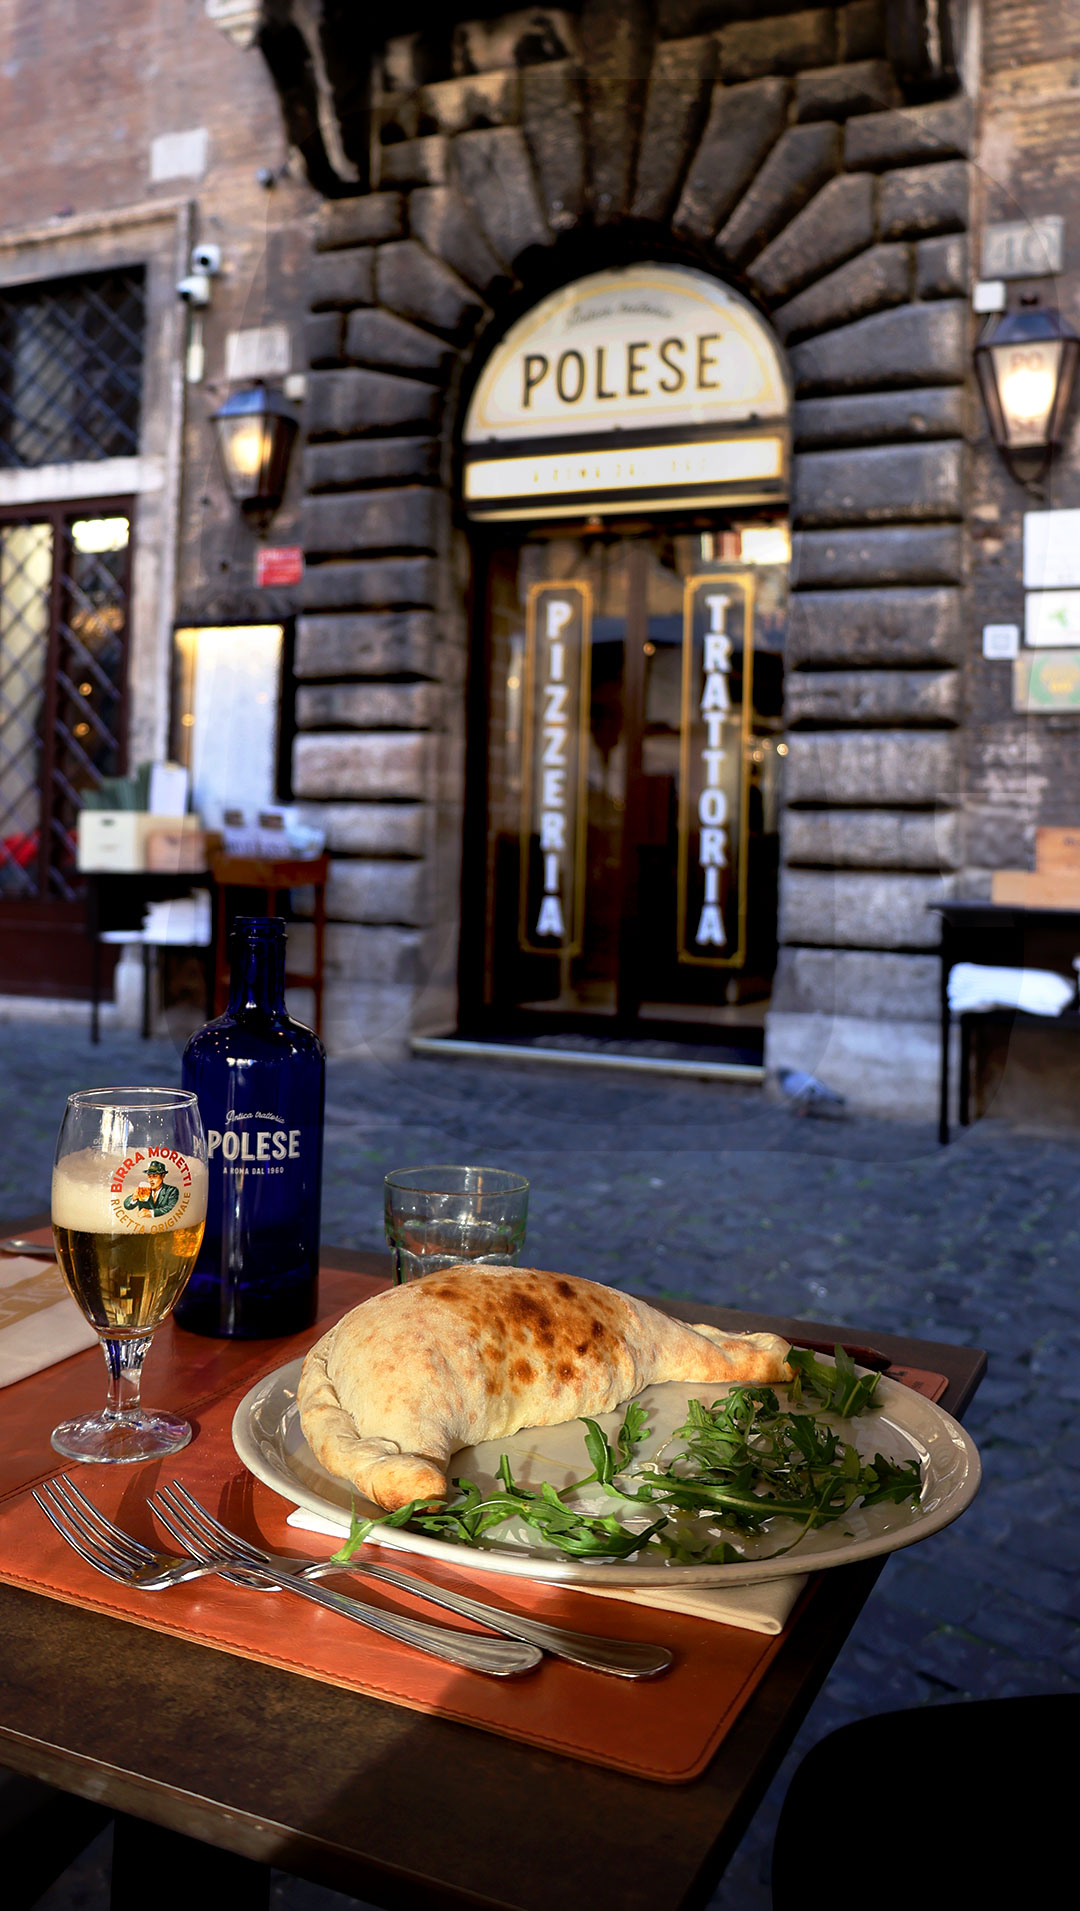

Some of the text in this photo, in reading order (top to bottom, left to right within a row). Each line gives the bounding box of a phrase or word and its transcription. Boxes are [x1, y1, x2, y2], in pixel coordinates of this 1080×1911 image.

[521, 332, 722, 409] POLESE
[535, 599, 573, 939] PIZZERIA
[695, 593, 733, 948] TRATTORIA
[225, 1110, 285, 1125] Antica trattoria
[207, 1129, 301, 1161] POLESE
[110, 1151, 145, 1193] BIRRA
[148, 1145, 192, 1187] MORETTI
[223, 1165, 285, 1175] A ROMA DAL 1960
[110, 1192, 191, 1234] RICETTA ORIGINALE
